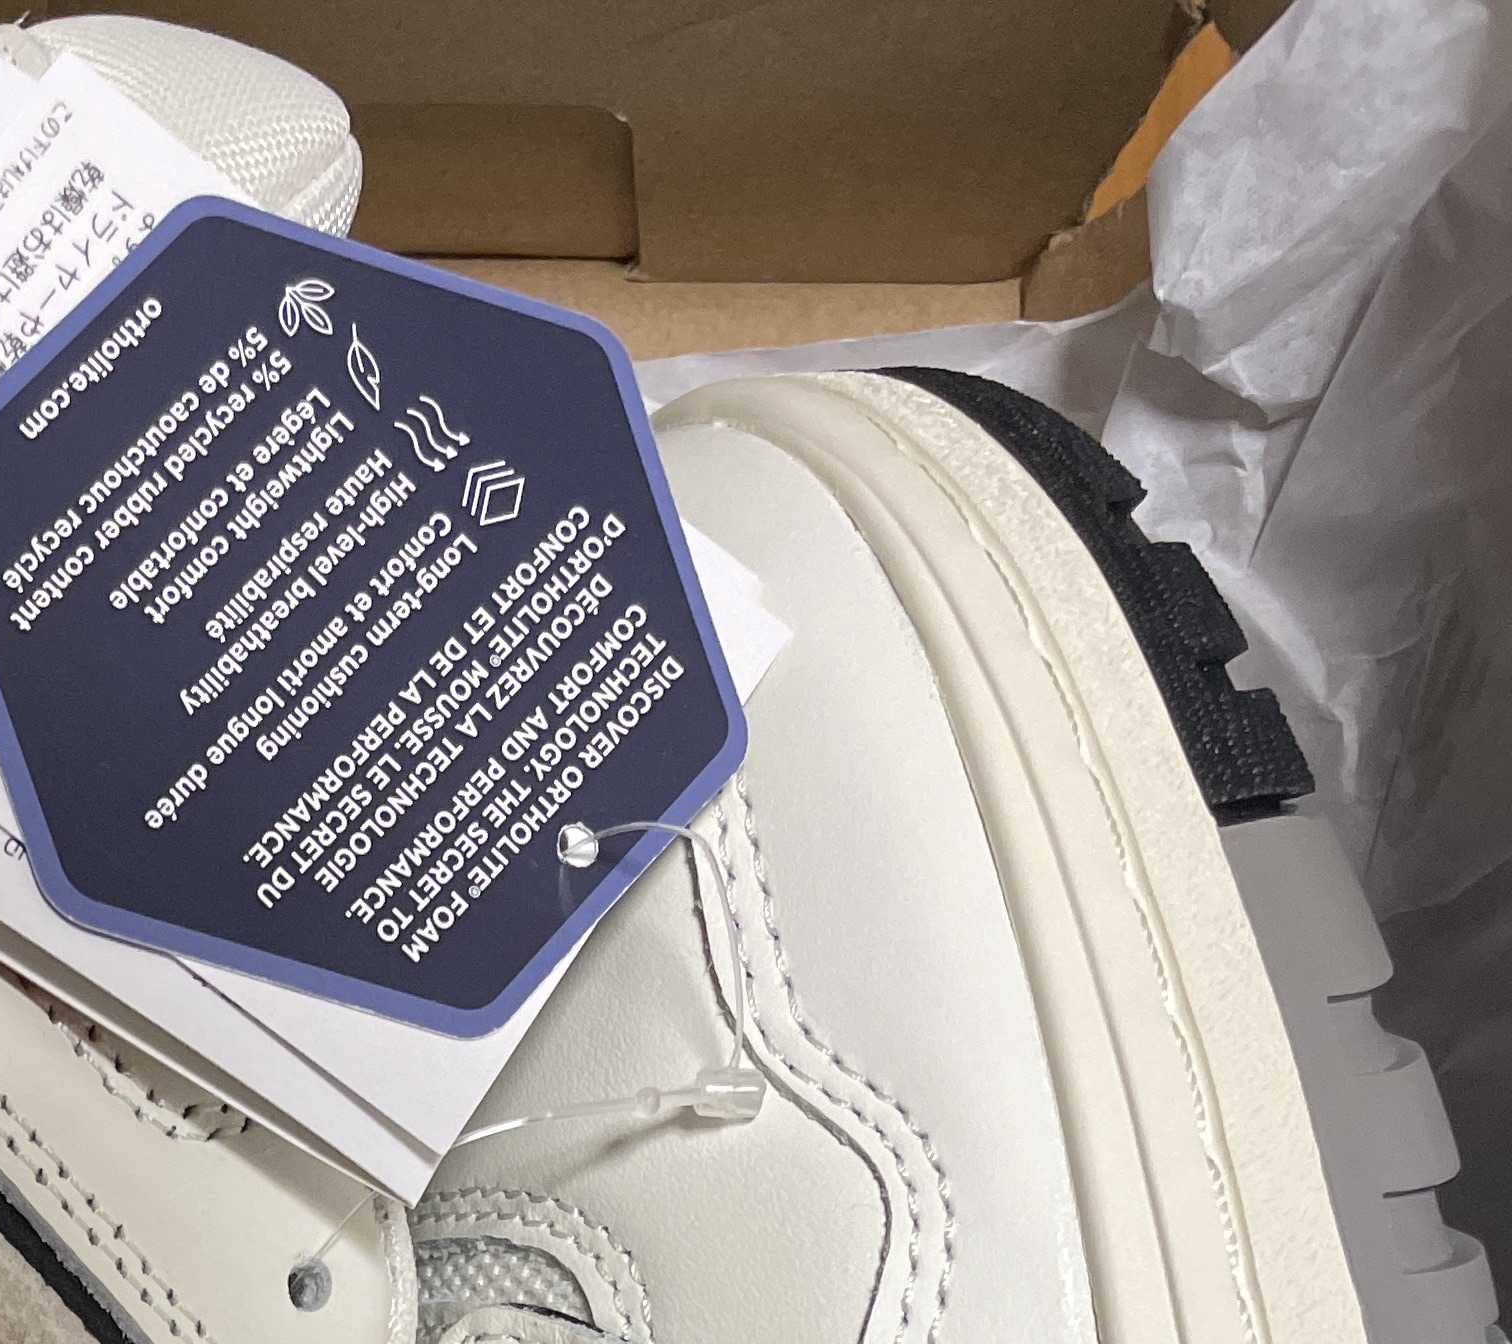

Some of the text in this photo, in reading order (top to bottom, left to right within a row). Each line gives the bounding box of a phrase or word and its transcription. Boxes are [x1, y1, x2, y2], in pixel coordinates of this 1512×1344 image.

[1, 325, 270, 595] 5% de caoutchouc recyclé
[18, 296, 163, 440] ortholite.com
[8, 348, 293, 632] 5% recycled rubber content
[108, 385, 332, 611] Légère et confortable
[142, 409, 356, 626] Lightweight comfort
[178, 470, 418, 717] High-level breathability
[204, 447, 394, 645] Haute respirabilité
[143, 510, 453, 830] Confort et amorti longue durée
[241, 505, 591, 869] CONFORT ET DE LA PERFORMANCE.
[254, 532, 479, 762] Long-term cushioning
[313, 571, 614, 894] DÉCOUVREZ LA TECHNOLOGIE
[393, 658, 491, 757] MOUSSE.
[576, 654, 686, 770] DISCOVER
[289, 782, 374, 875] SECRET
[344, 603, 648, 925] COMFORT AND PERFORMANCE.
[364, 751, 403, 792] LE
[376, 631, 668, 943] TECHNOLOGY. THE SECRET TO
[256, 865, 296, 910] DU
[400, 889, 470, 964] FOAM
